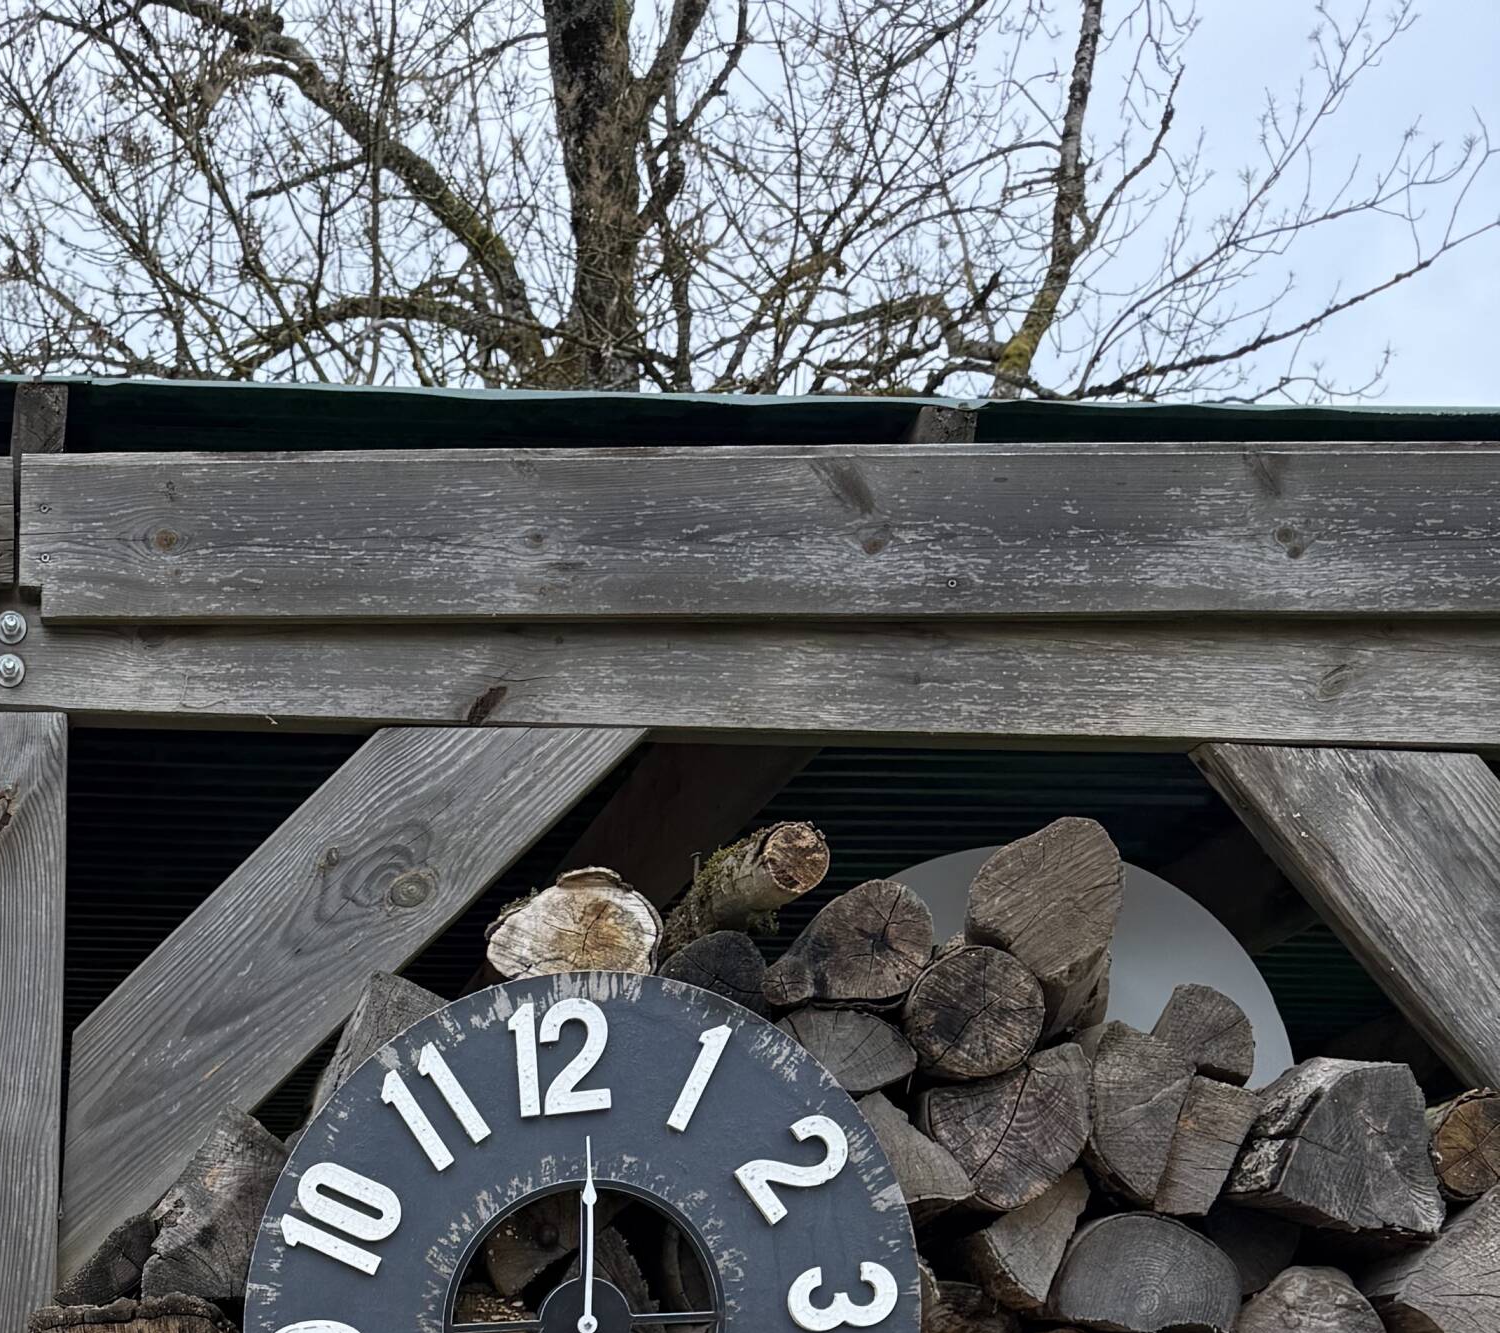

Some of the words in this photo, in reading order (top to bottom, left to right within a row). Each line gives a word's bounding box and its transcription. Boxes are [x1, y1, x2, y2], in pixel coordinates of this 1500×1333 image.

[380, 1042, 491, 1171] 11
[508, 998, 611, 1117] 12
[666, 1024, 732, 1131] 1
[281, 1162, 401, 1275] 10
[734, 1115, 848, 1225] 2
[788, 1261, 898, 1331] 3
